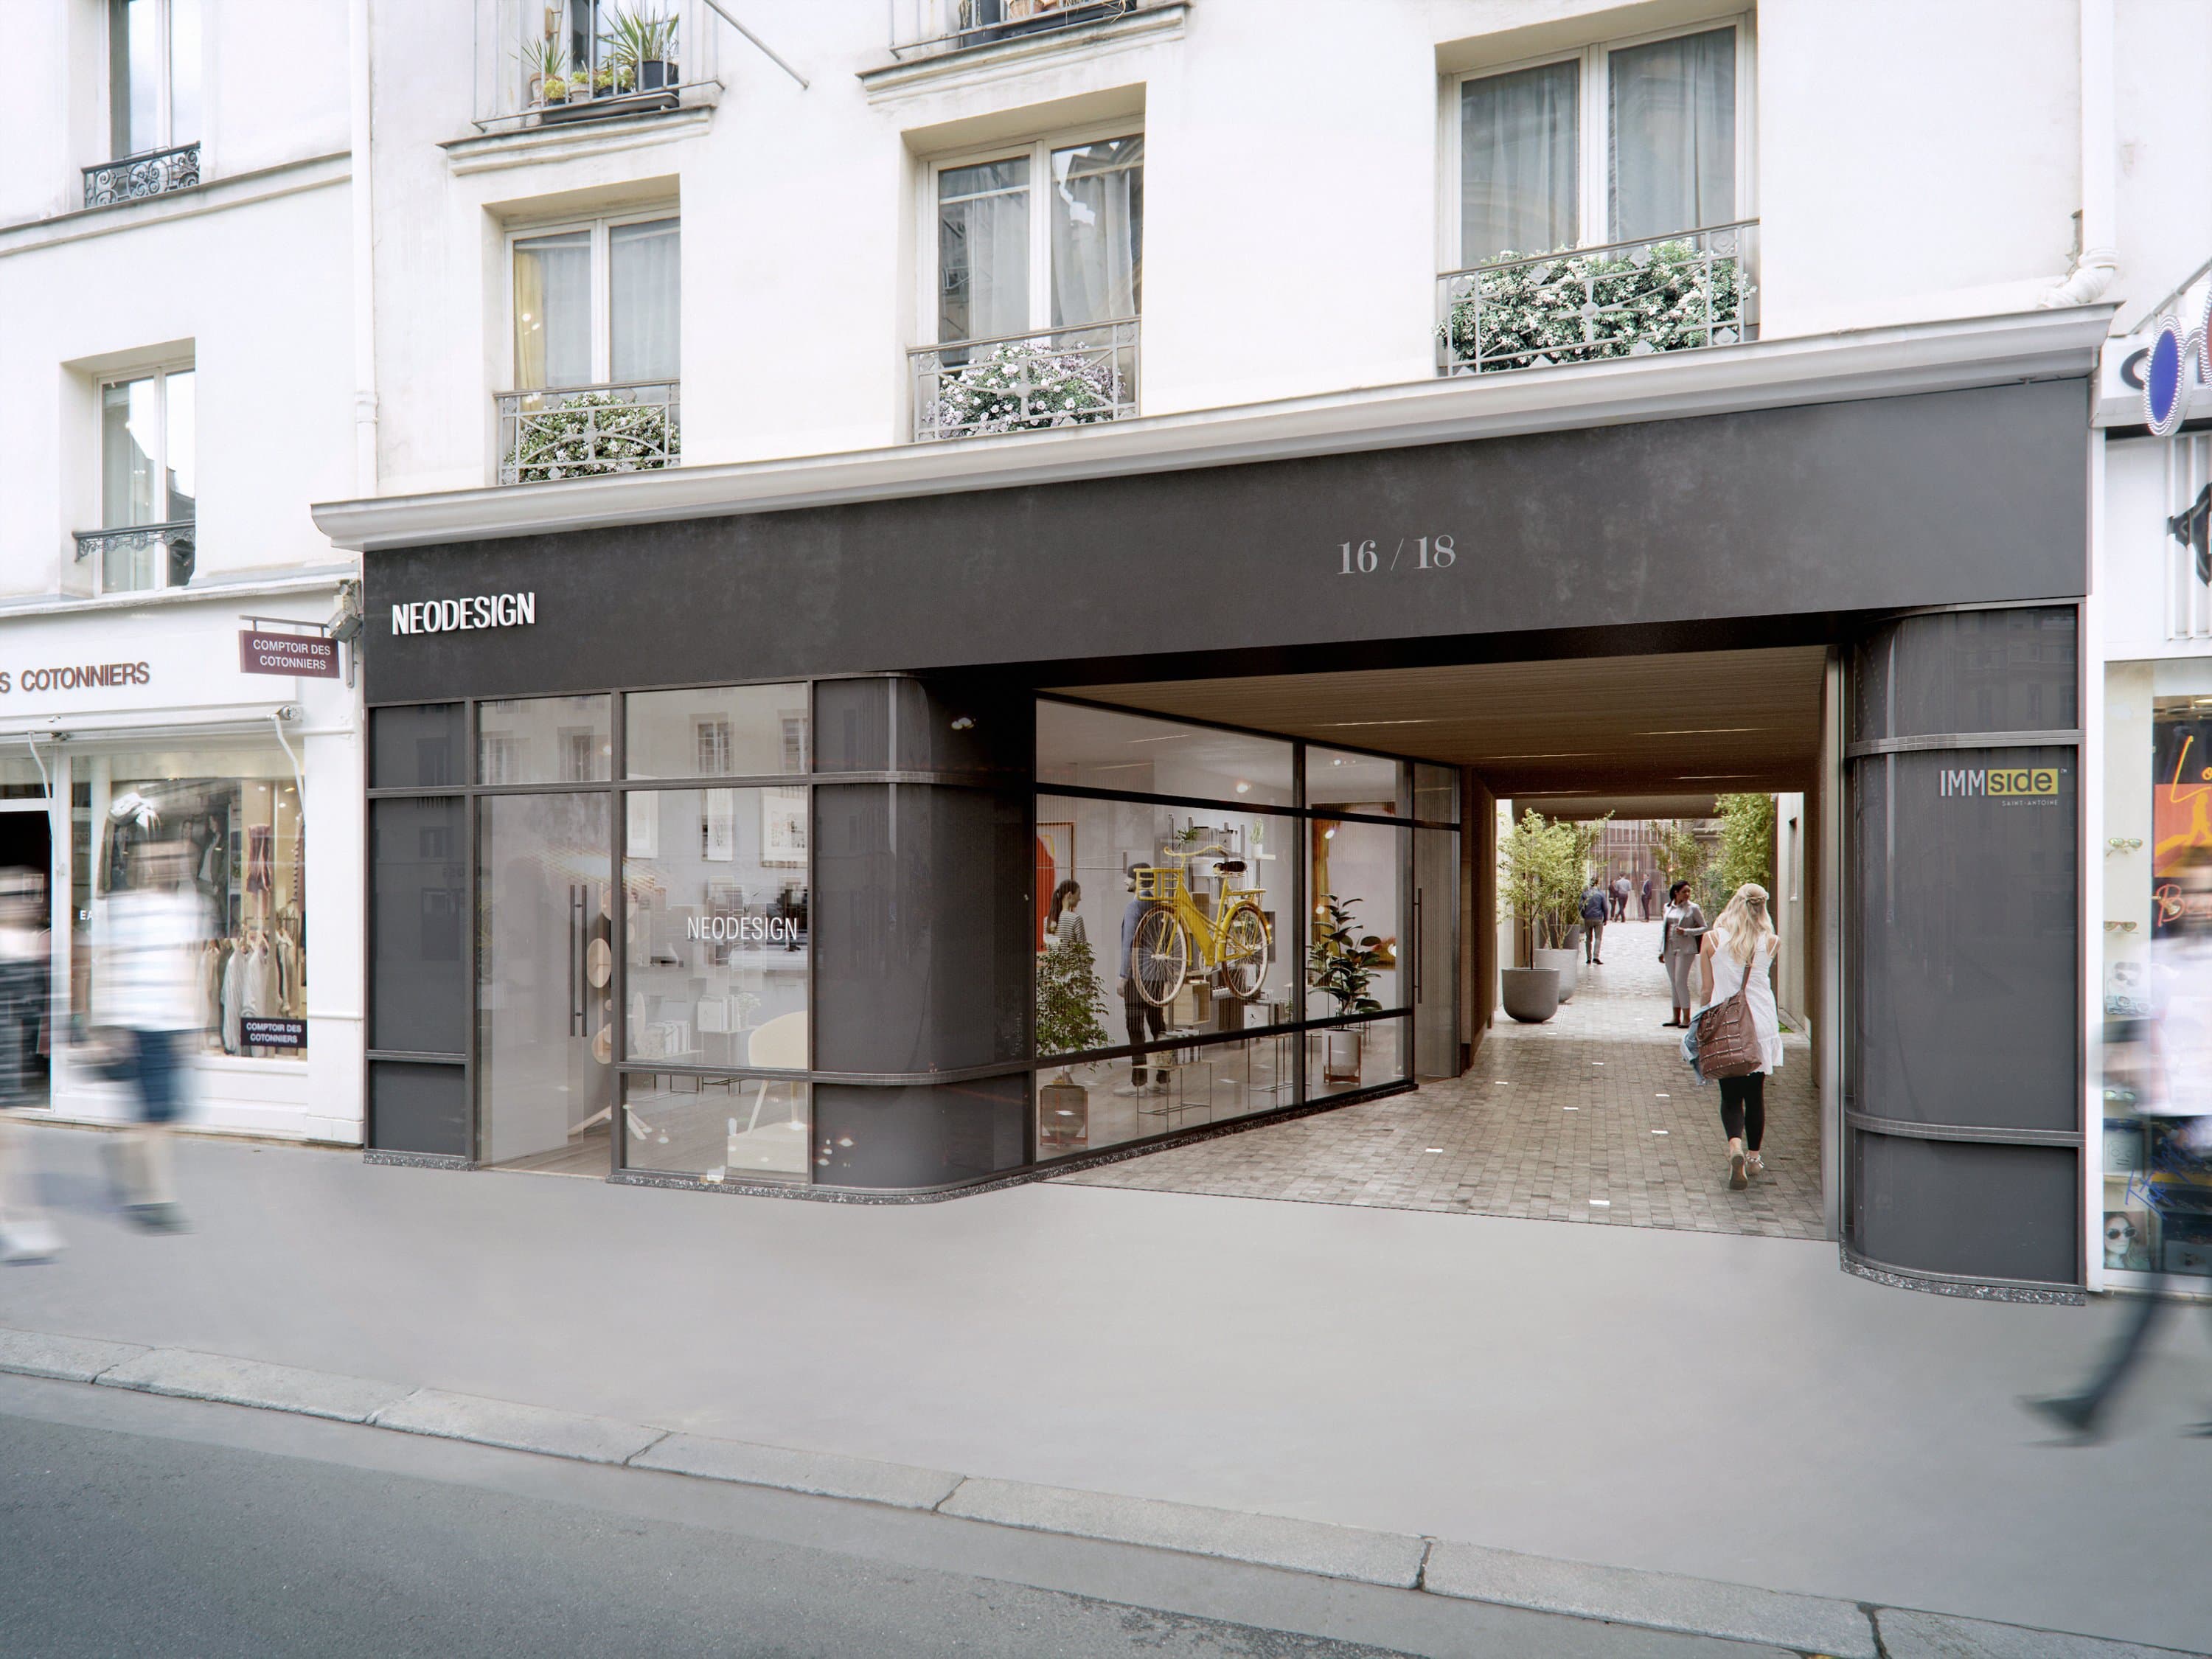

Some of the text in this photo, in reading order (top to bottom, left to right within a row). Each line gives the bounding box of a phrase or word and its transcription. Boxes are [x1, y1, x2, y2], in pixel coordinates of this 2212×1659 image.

[1336, 535, 1456, 574] 16 / 18
[392, 592, 535, 636] NEODESIGN
[253, 639, 331, 655] COMPTOIR DES
[260, 655, 326, 670] COTONNIERS
[21, 661, 150, 692] COTONNIERS
[2001, 799, 2059, 807] SAINT-ANTOINE
[687, 917, 798, 941] NEODESIGN
[246, 1022, 302, 1033] COMPTOIR DES
[250, 1033, 298, 1044] COTONNIERS
